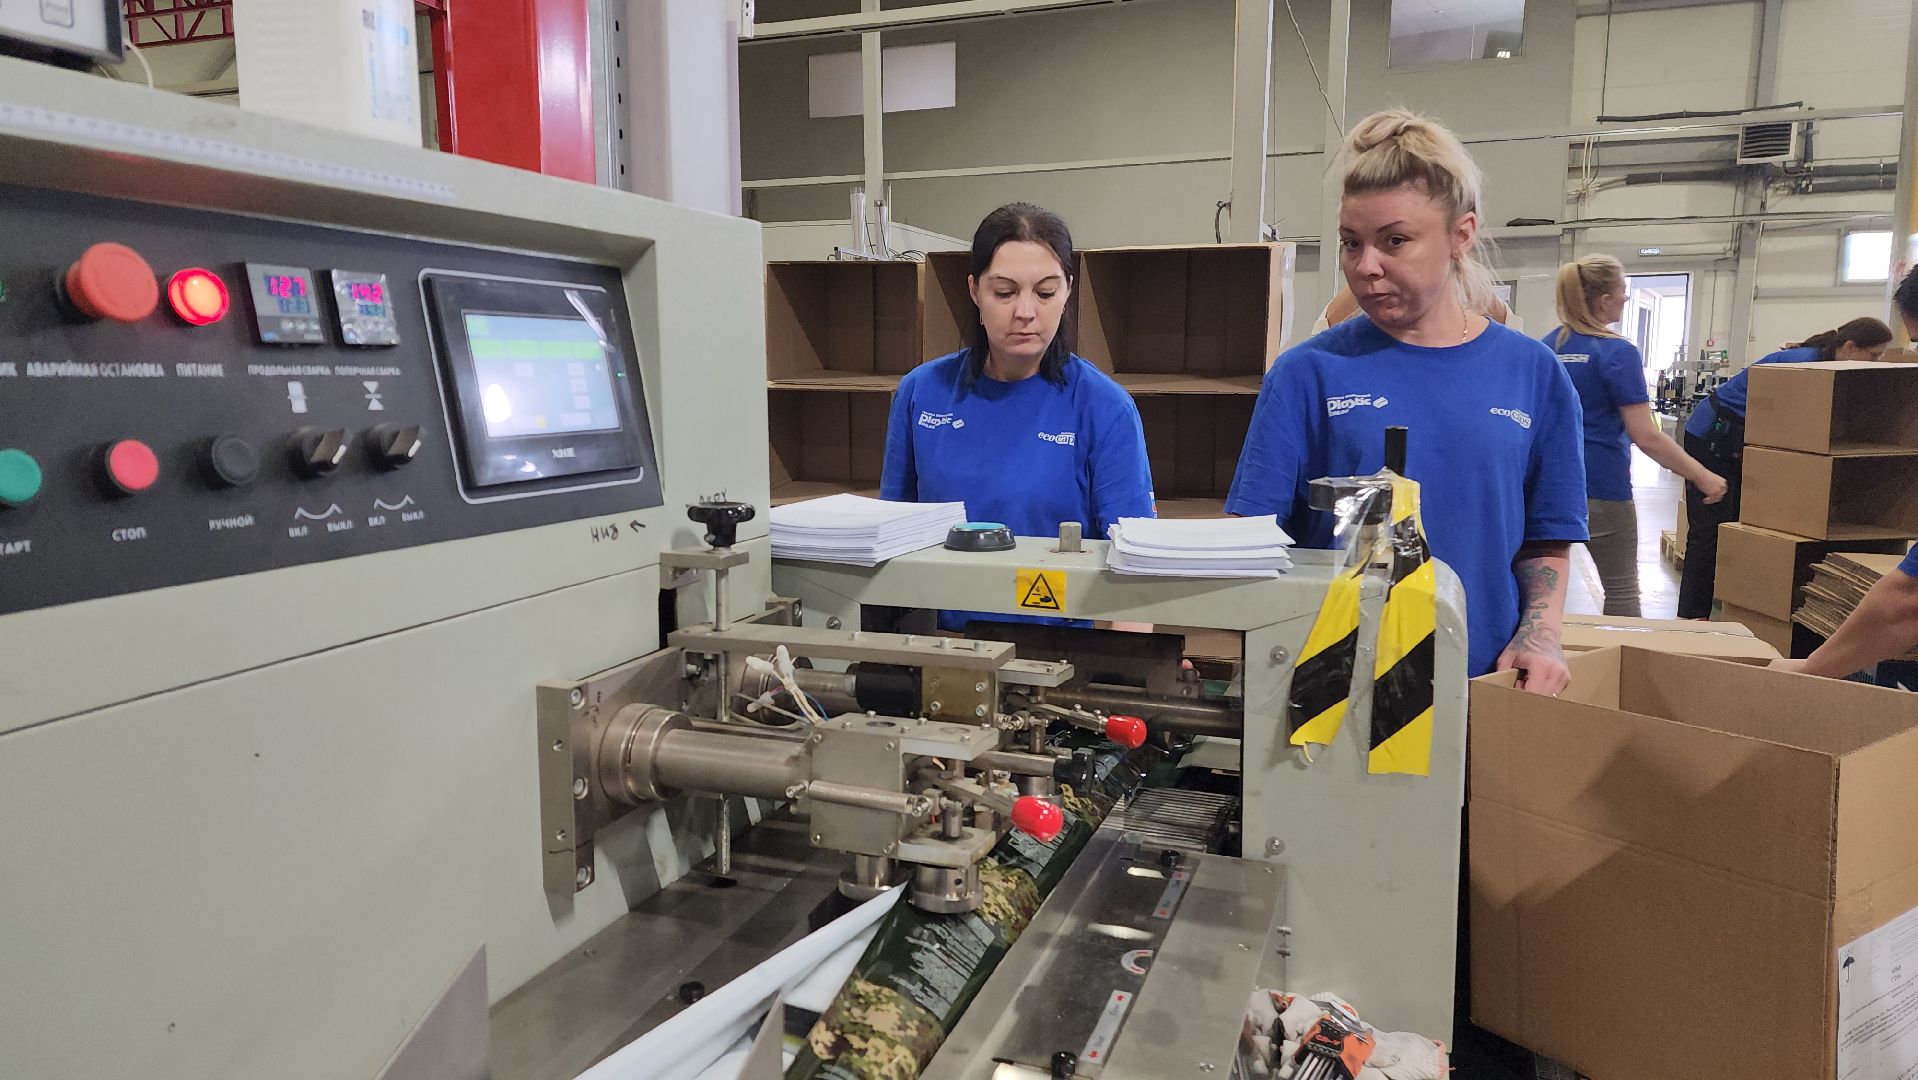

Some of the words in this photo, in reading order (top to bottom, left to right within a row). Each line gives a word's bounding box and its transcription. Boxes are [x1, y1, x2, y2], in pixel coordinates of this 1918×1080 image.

[270, 275, 306, 298] 127
[351, 282, 383, 304] 142
[27, 360, 99, 377] АВАРИЙНАЯ
[100, 362, 164, 377] ОСТАНОВКА
[176, 363, 224, 377] ПИТАНИЕ
[209, 514, 255, 531] РУЧНОЙ
[368, 515, 386, 527] ВКЛ
[401, 510, 425, 522] ВЫКЛ
[112, 527, 147, 542] СТОП
[289, 525, 308, 538] ВКЛ
[327, 520, 353, 532] ВЫКЛ
